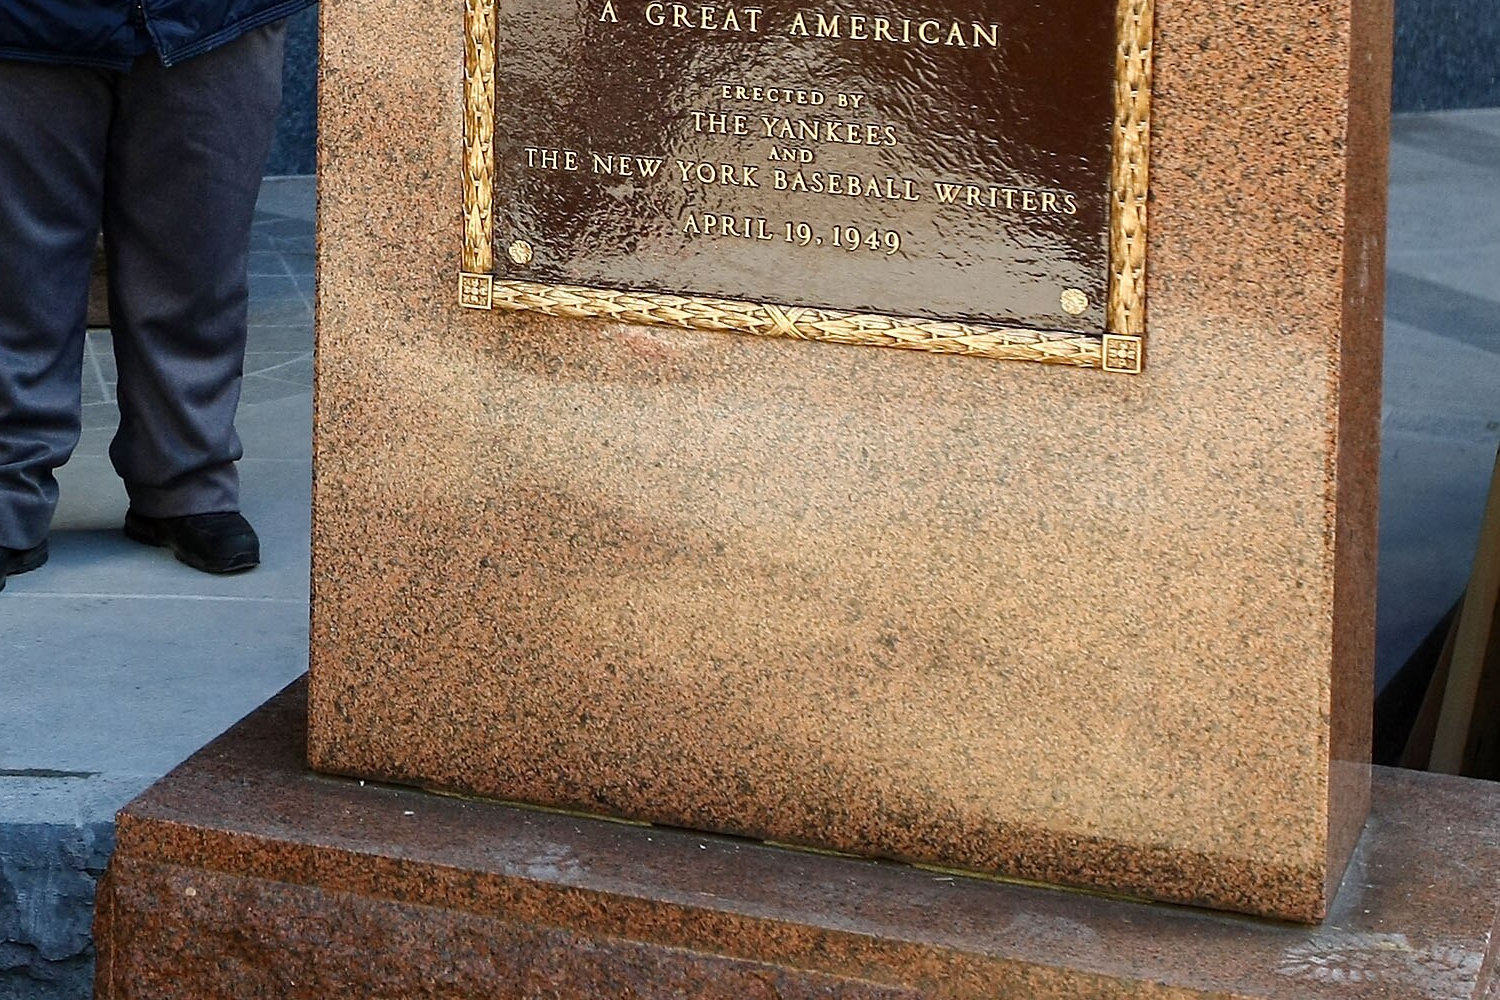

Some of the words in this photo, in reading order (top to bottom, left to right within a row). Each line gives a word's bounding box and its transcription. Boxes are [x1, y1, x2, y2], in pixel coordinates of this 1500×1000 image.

[599, 1, 619, 23] A
[646, 2, 764, 34] GREAT
[789, 12, 1000, 47] AMERICAN
[722, 85, 825, 107] ERECTED
[837, 93, 866, 108] BY
[690, 111, 749, 136] THE
[762, 117, 898, 147] YANKEES
[769, 147, 814, 163] AND
[524, 146, 580, 172] THE
[593, 153, 663, 179] NEW
[676, 159, 759, 188] YORK
[773, 169, 921, 202] BASEBALL
[933, 183, 1078, 215] WRITERS
[682, 213, 774, 241] APRIL
[784, 221, 822, 247] 19,
[832, 224, 902, 255] 1949
